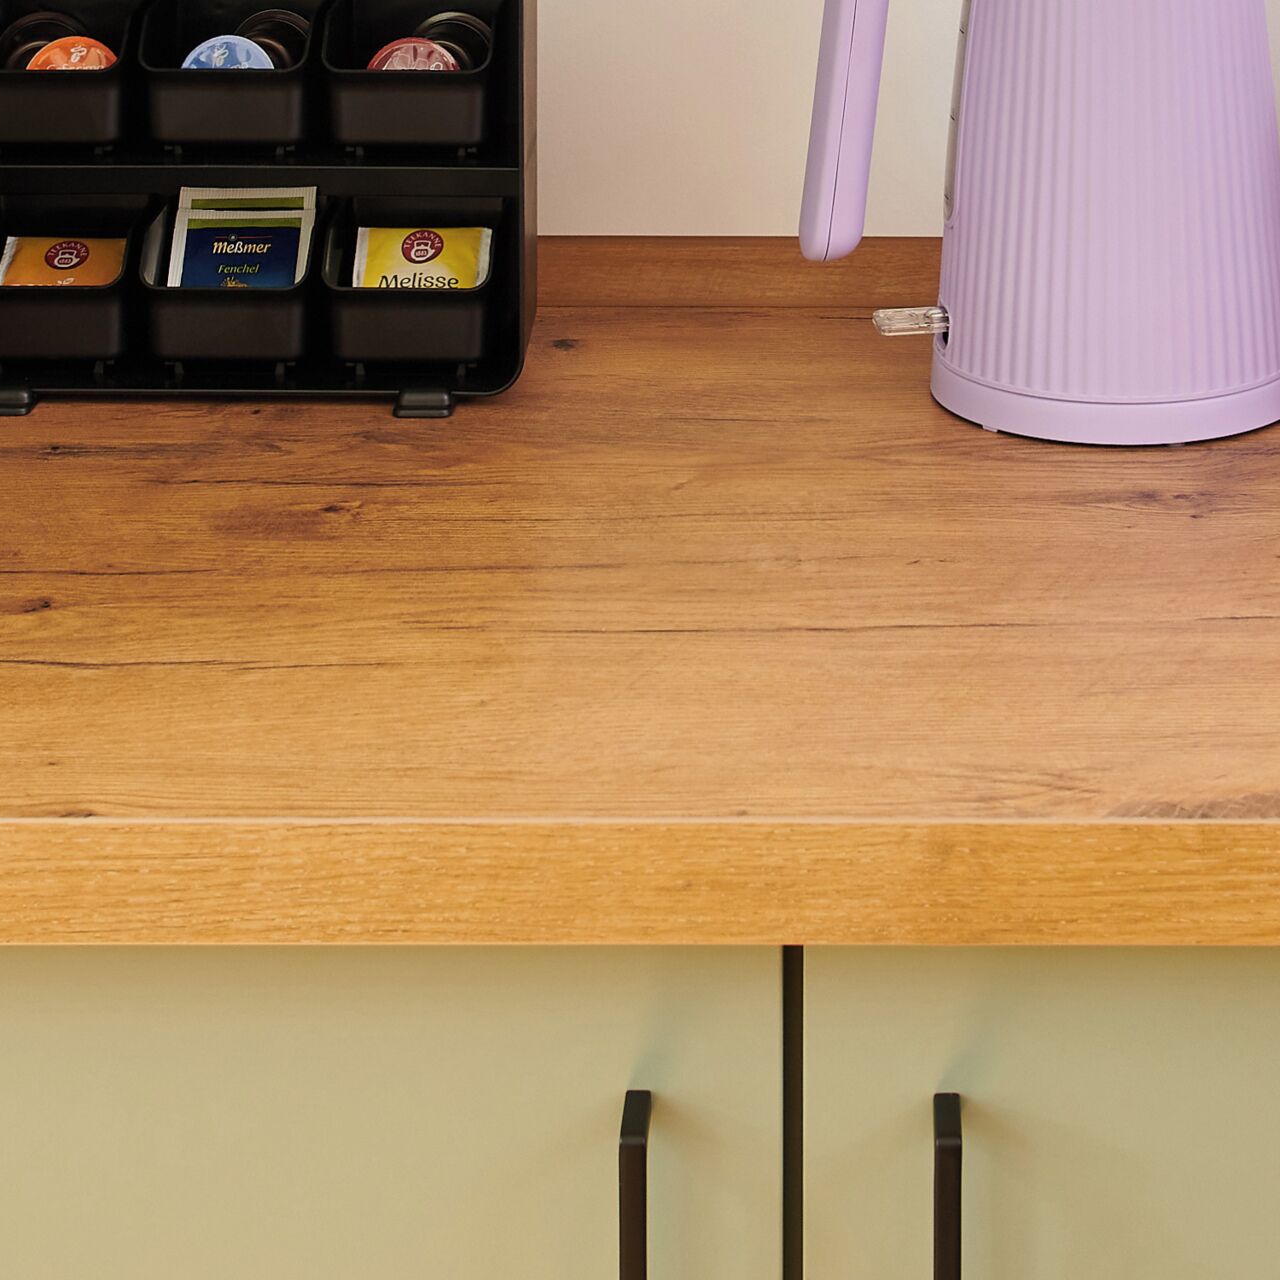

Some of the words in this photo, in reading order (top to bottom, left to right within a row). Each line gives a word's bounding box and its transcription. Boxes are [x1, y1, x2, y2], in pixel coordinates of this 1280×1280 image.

[403, 231, 442, 249] TEEKANNE
[212, 241, 272, 254] Meßmer
[217, 263, 260, 274] Fenchel
[378, 272, 459, 288] Melisse
